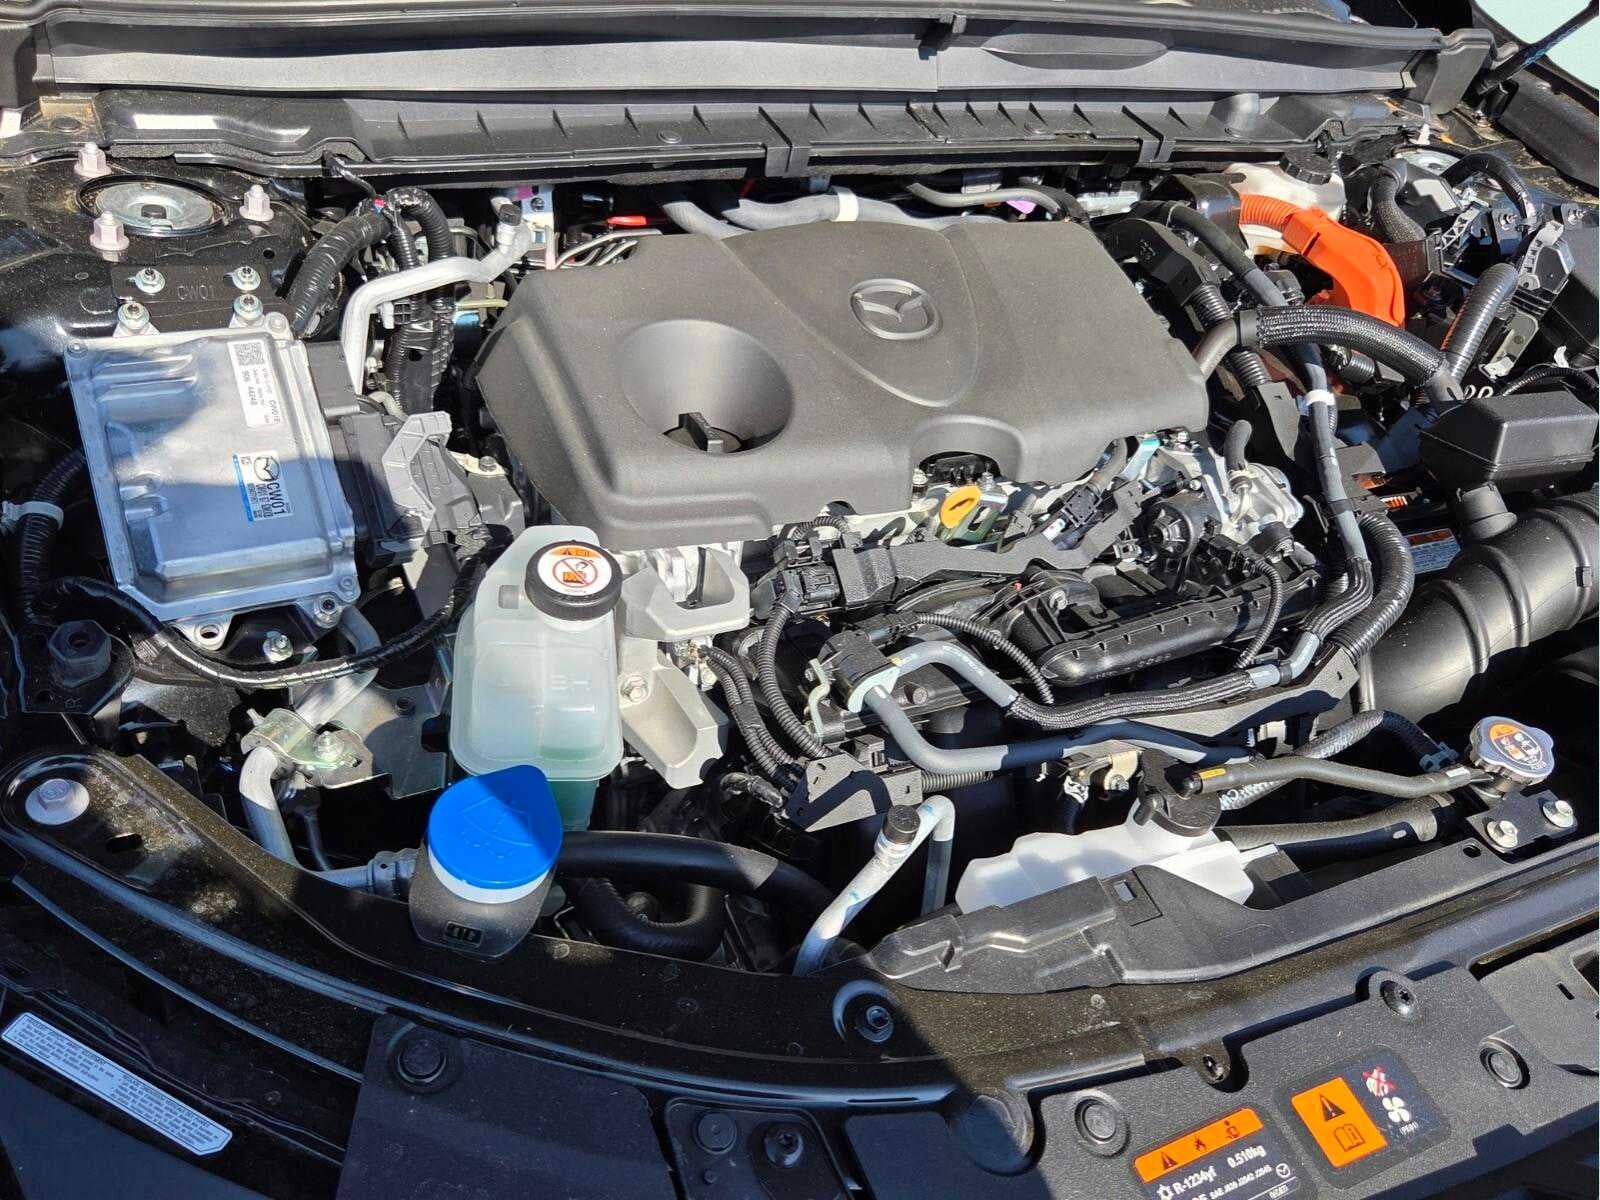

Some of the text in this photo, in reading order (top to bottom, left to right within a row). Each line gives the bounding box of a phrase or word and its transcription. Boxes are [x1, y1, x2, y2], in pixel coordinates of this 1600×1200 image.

[266, 482, 286, 515] CW01
[1172, 1145, 1267, 1195] R-1234yf 0.510kg
